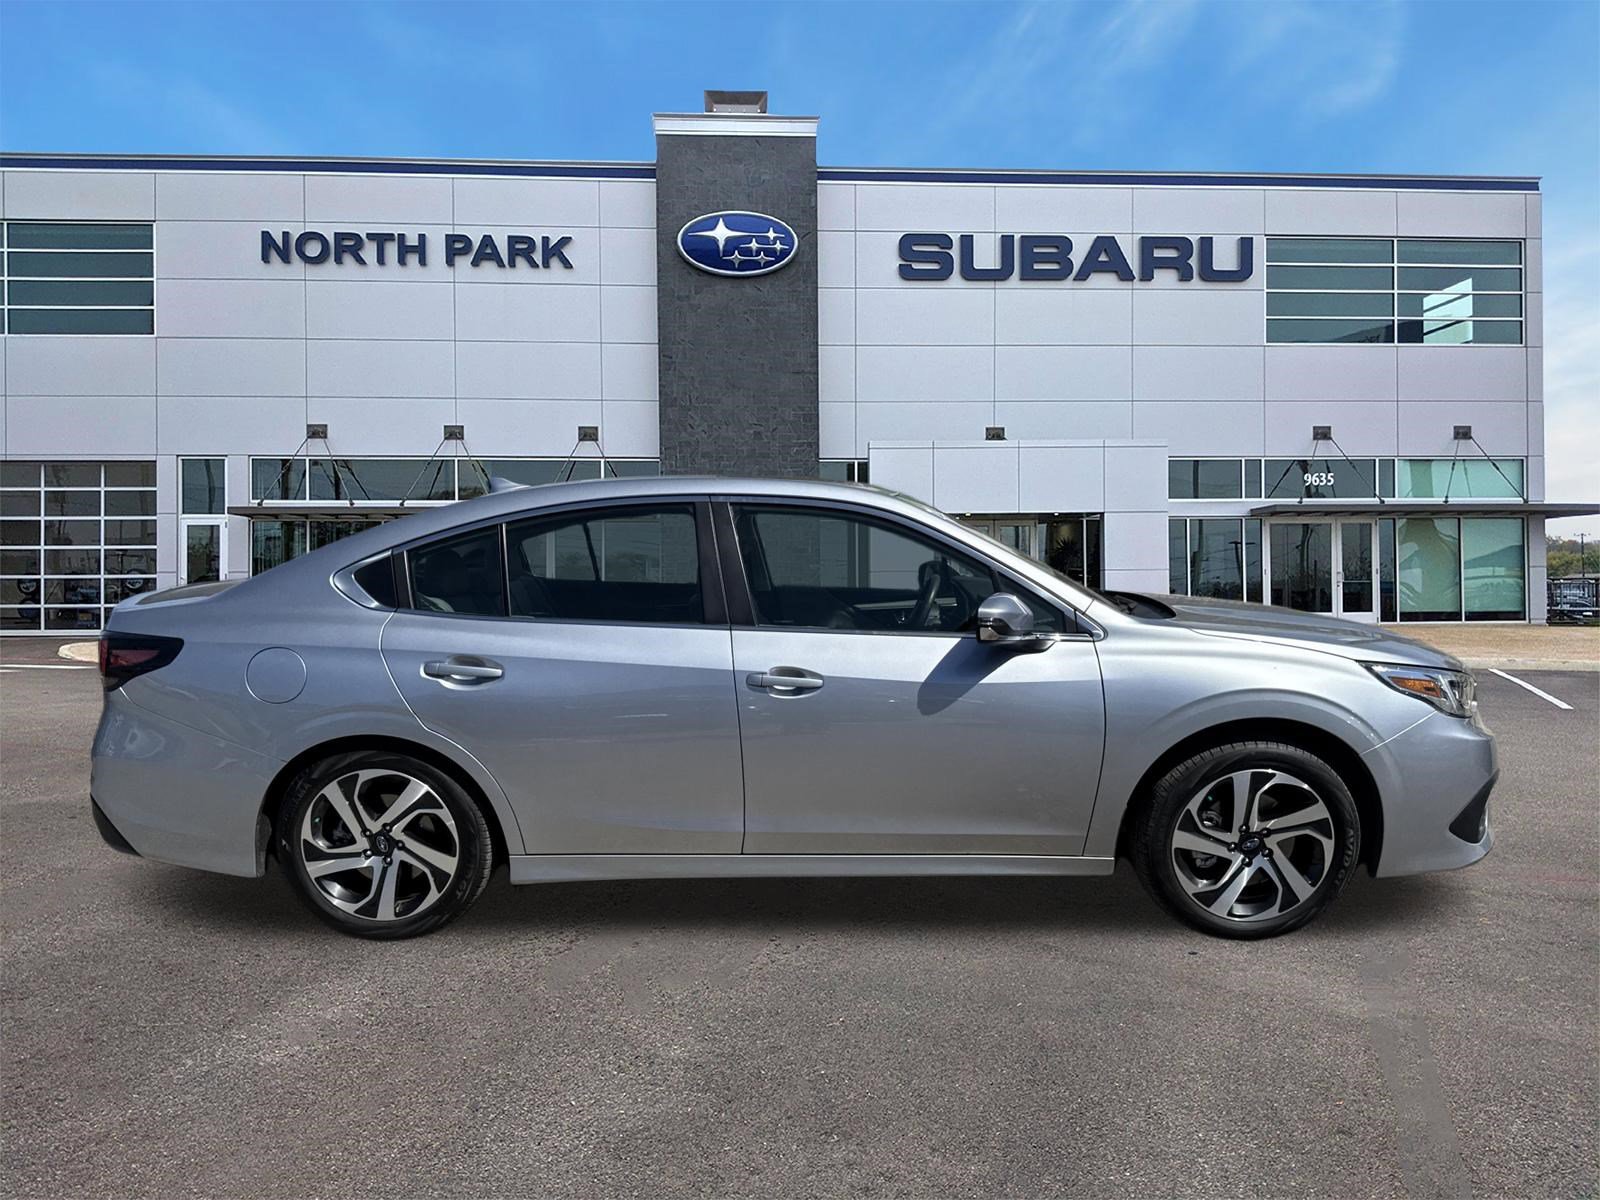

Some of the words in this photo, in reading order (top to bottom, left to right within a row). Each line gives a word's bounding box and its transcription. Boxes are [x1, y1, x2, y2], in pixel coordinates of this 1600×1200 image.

[260, 230, 427, 266] NORTH
[444, 233, 574, 269] PARK
[898, 233, 1254, 282] SUBARU
[1303, 472, 1335, 486] 9635
